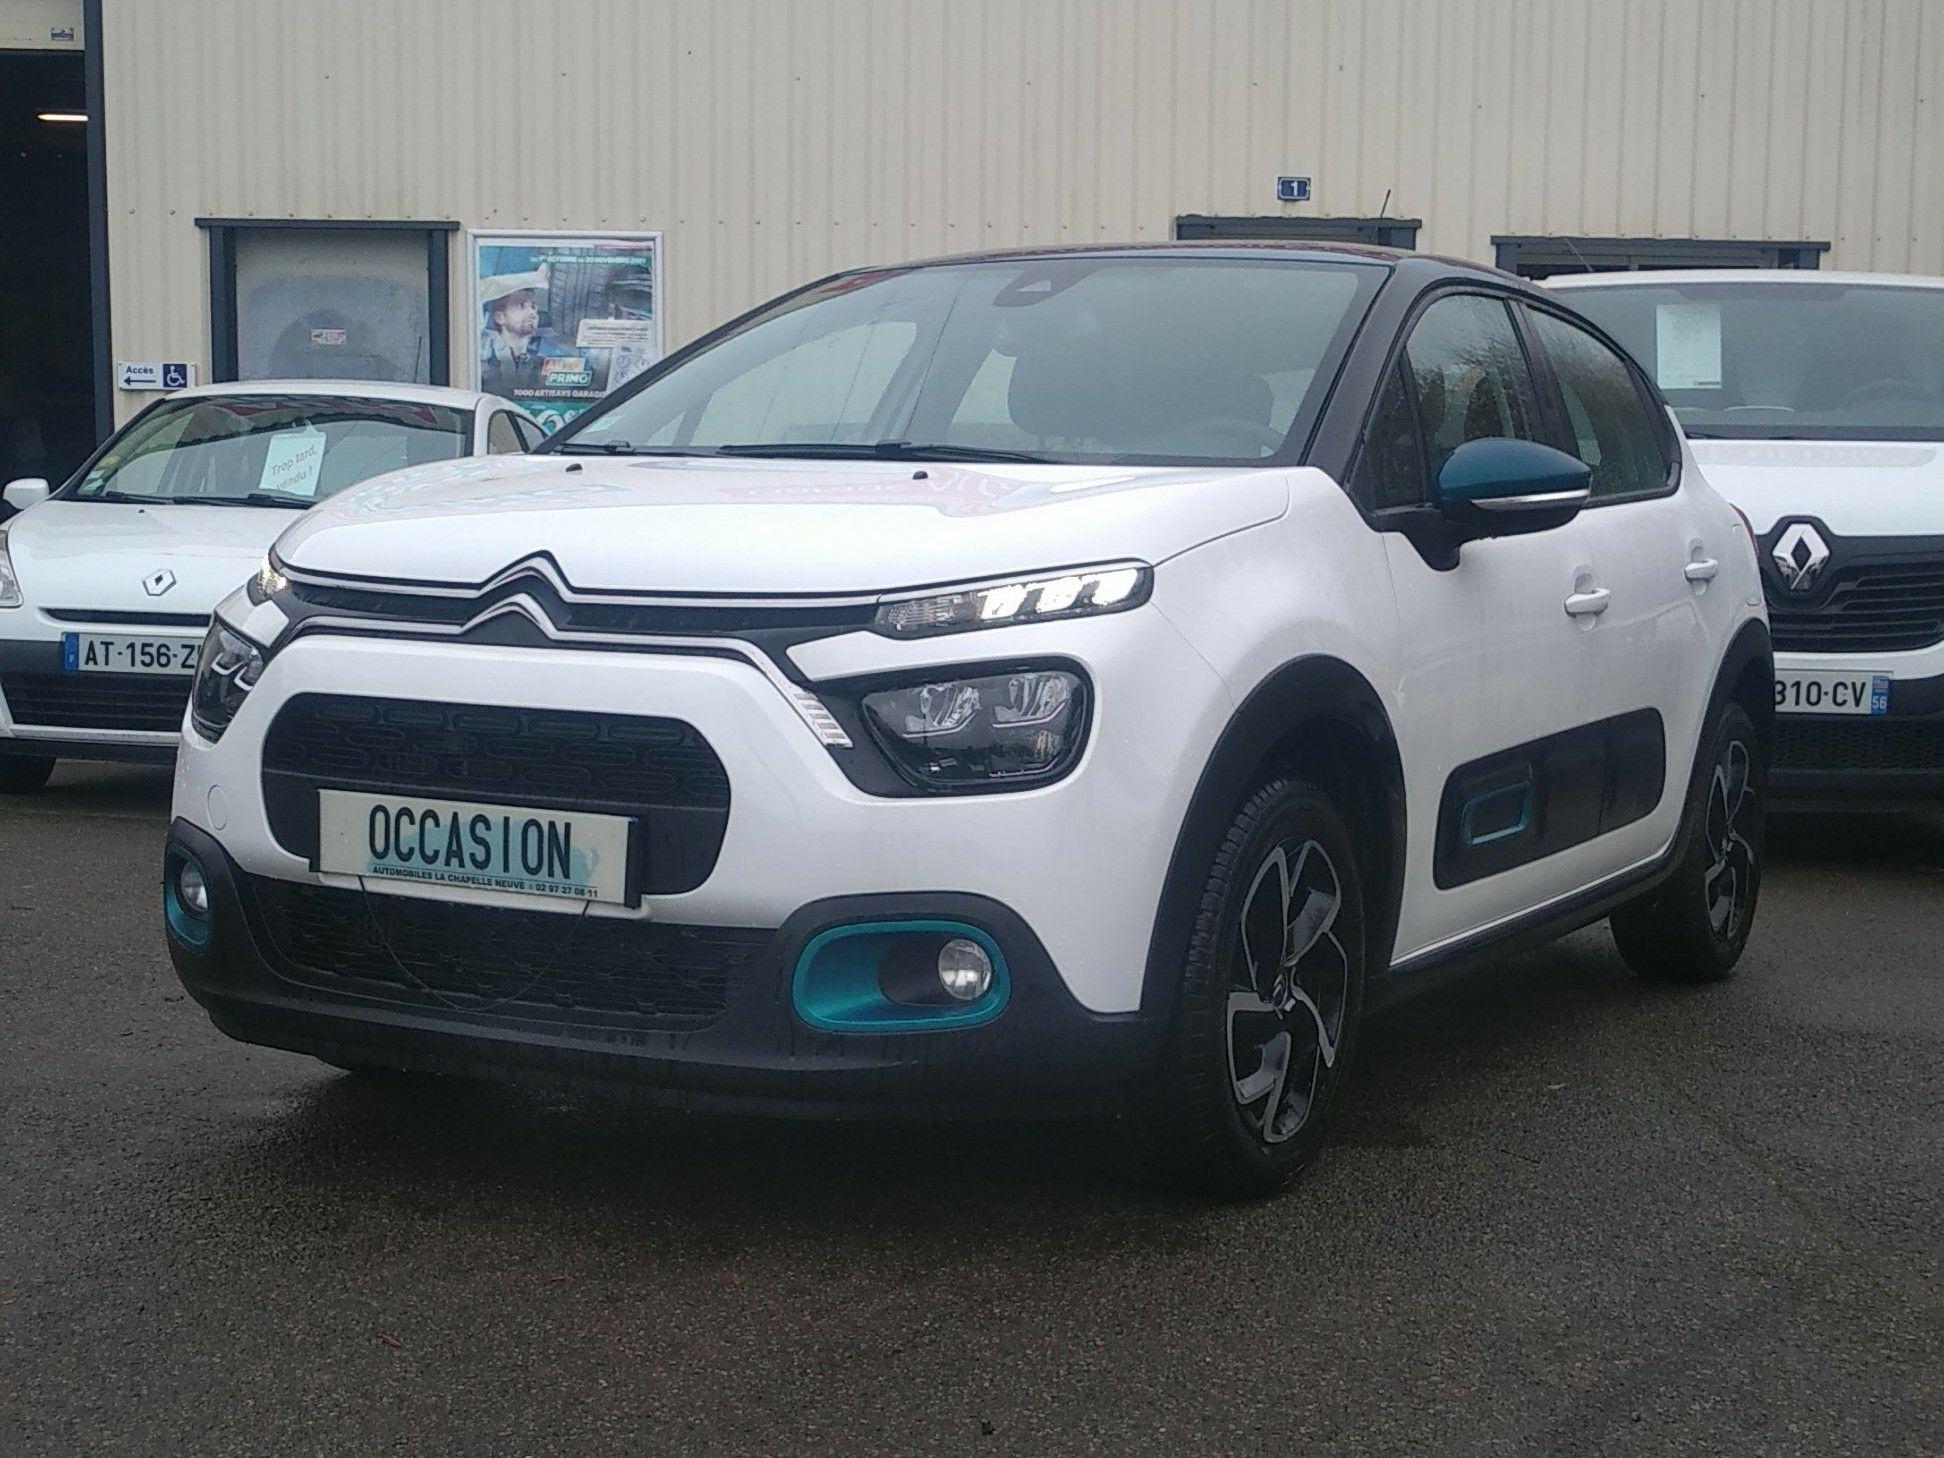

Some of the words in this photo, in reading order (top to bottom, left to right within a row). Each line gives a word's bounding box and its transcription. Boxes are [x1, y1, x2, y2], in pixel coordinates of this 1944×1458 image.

[1290, 181, 1298, 196] 1
[126, 365, 154, 374] Accès
[550, 373, 589, 384] PRIMO
[535, 389, 571, 398] ARTISANS
[272, 459, 294, 476] Trop
[84, 640, 201, 669] AT-156-Z
[1872, 695, 1888, 710] 56
[369, 804, 571, 879] OCCASION
[373, 866, 433, 879] AUTOMOBILES
[435, 872, 446, 880] LA
[447, 874, 493, 887] CHAPELLE
[495, 879, 526, 889] NEUVE
[535, 883, 547, 892] 02
[561, 886, 573, 895] 27
[588, 889, 599, 898] 11
